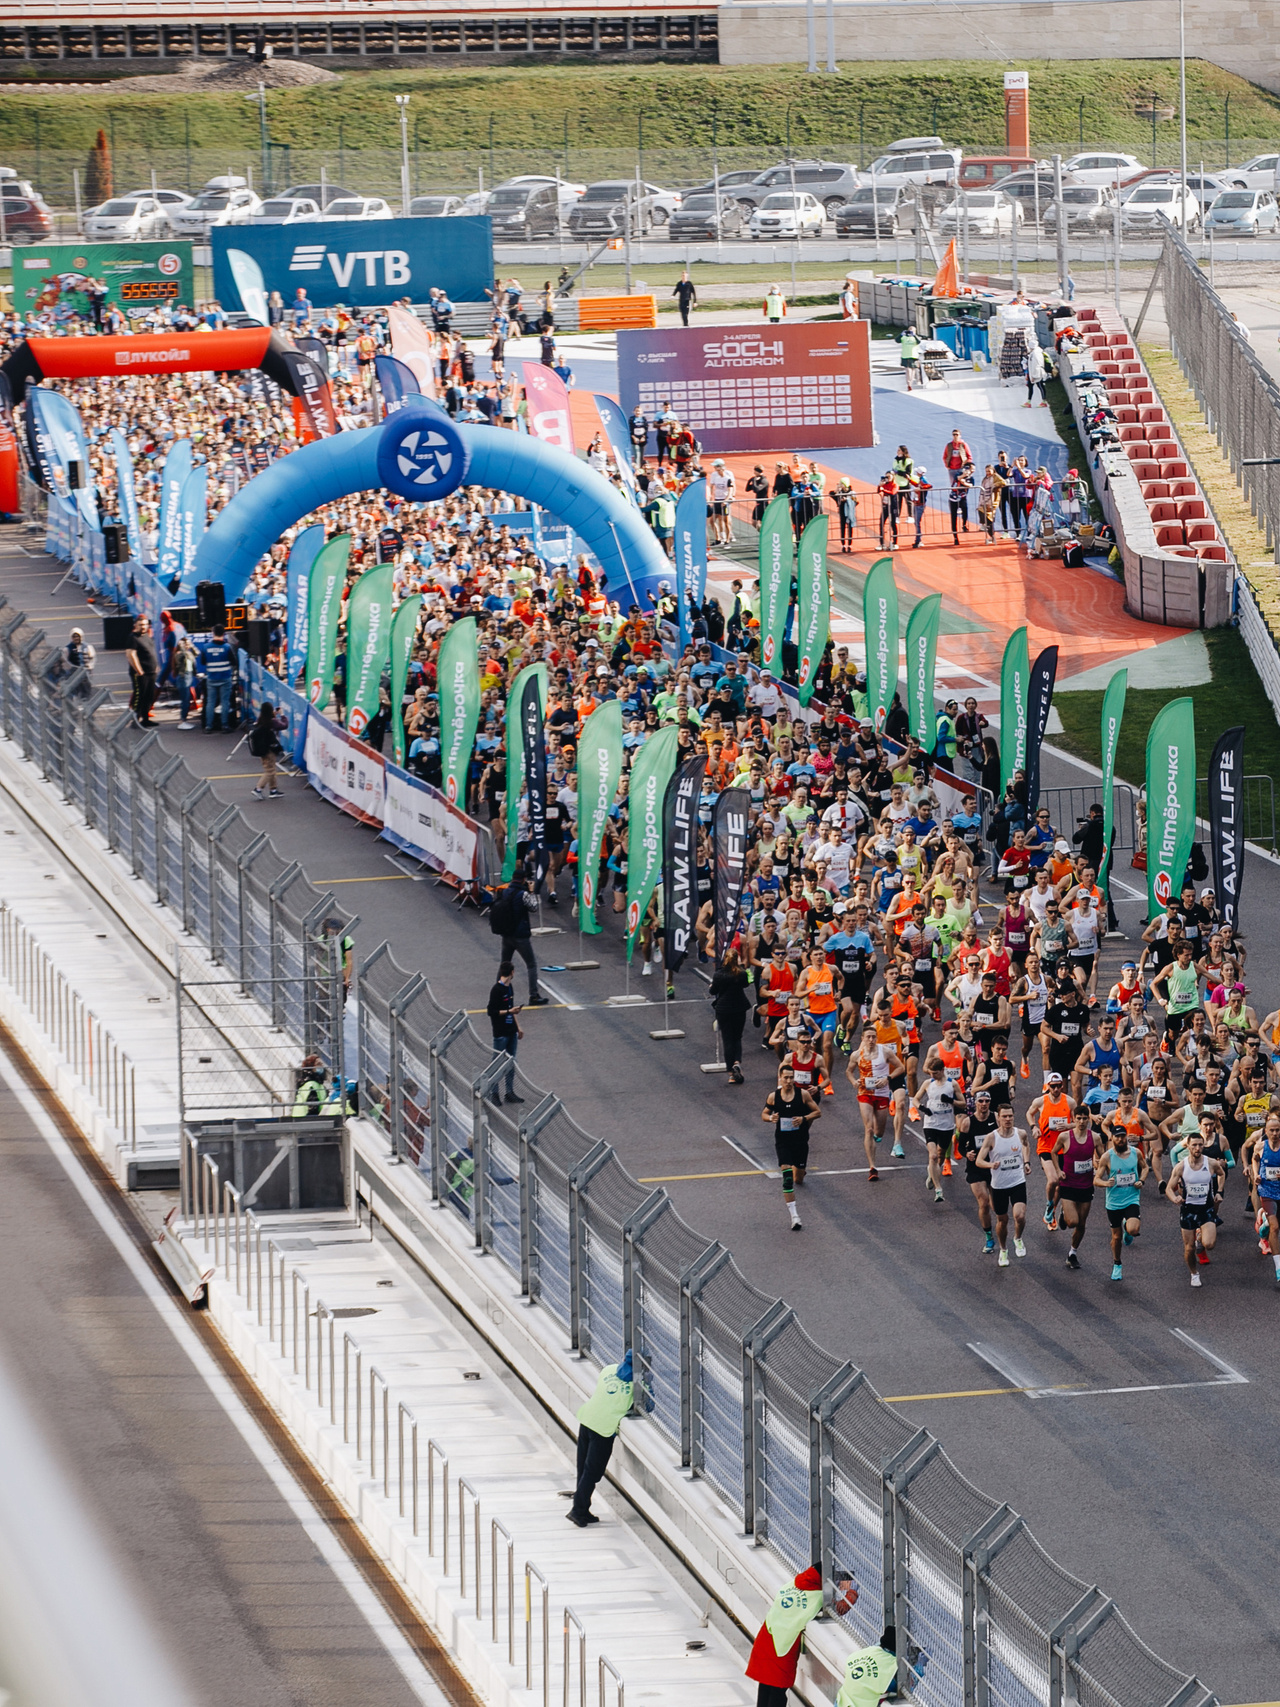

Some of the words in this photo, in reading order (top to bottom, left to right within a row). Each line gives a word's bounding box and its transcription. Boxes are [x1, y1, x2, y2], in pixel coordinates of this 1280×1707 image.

[326, 250, 412, 288] VTB
[129, 348, 190, 363] ЛУКОЙЛ
[703, 340, 784, 358] SOCHI
[704, 357, 784, 368] AUTODROM
[878, 597, 888, 702] Пятёрочка
[916, 636, 928, 744] Пятёрочка
[1157, 745, 1181, 867] Пятёрочка
[673, 777, 694, 951] R.A.W.LIFE
